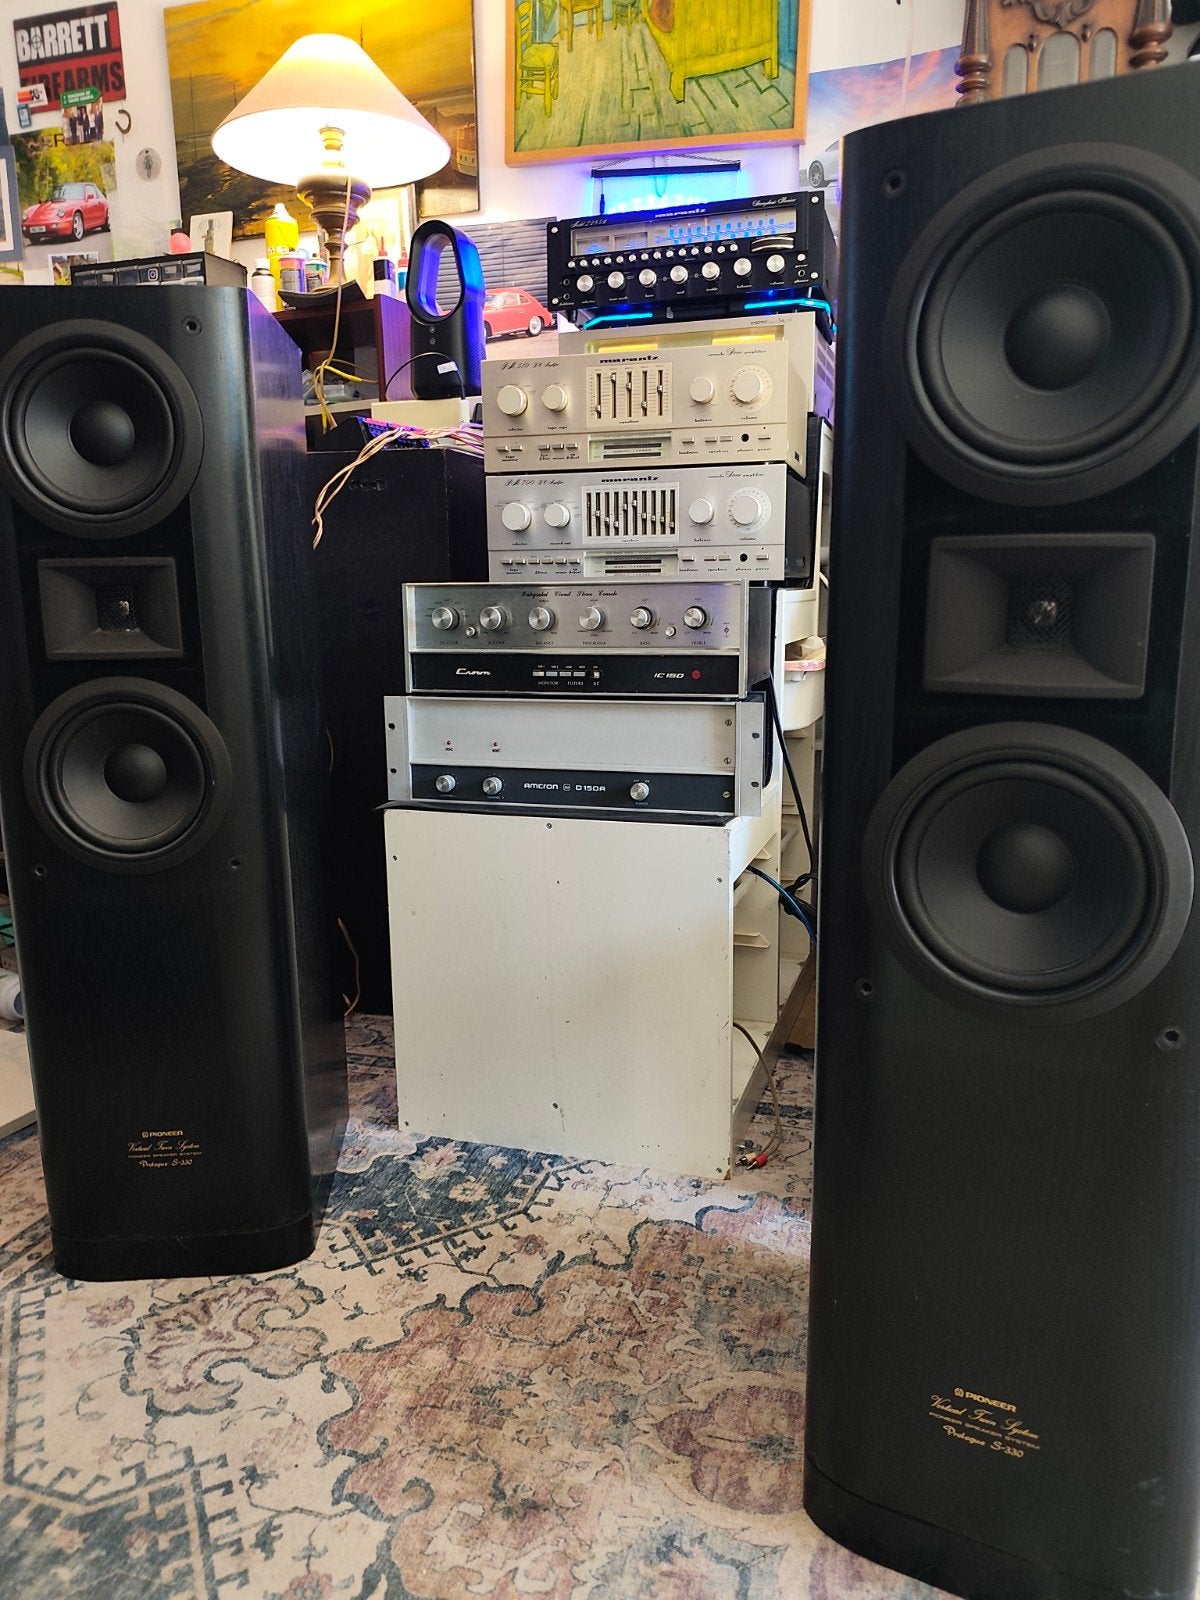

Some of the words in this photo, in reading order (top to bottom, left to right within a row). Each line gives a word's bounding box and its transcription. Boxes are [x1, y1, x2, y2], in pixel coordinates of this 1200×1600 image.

[15, 14, 107, 63] BARRETT
[600, 355, 659, 363] marantz
[149, 1130, 184, 1138] PIONEER
[965, 1390, 1017, 1413] PIONEER
[943, 1424, 986, 1446] Prologue
[990, 1440, 1024, 1458] S-330
